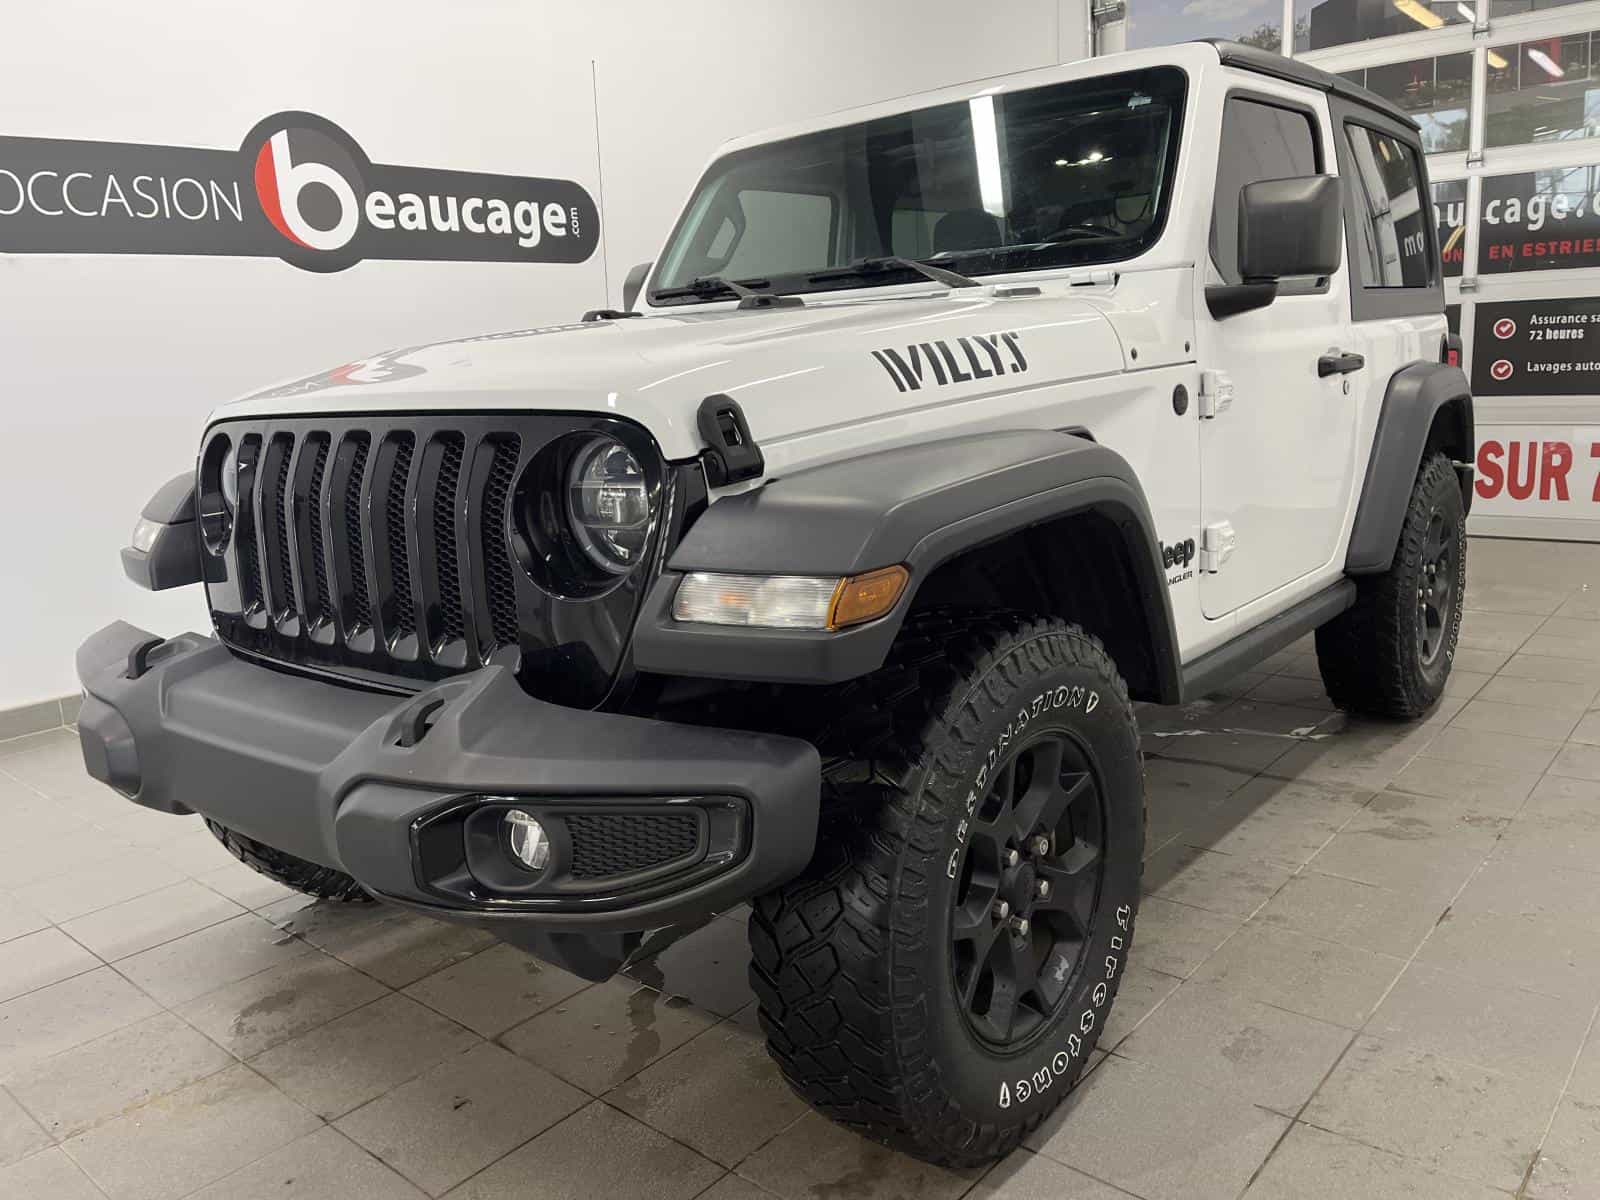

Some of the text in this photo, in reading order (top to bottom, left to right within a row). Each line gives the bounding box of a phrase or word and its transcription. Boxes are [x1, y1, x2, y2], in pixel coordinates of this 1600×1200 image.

[1488, 243, 1514, 260] EN
[1529, 314, 1588, 325] Assurance
[1528, 328, 1584, 341] 72 heures
[870, 331, 1028, 393] WILLYS
[1527, 361, 1600, 374] Lavages auto
[1474, 440, 1573, 501] SUR
